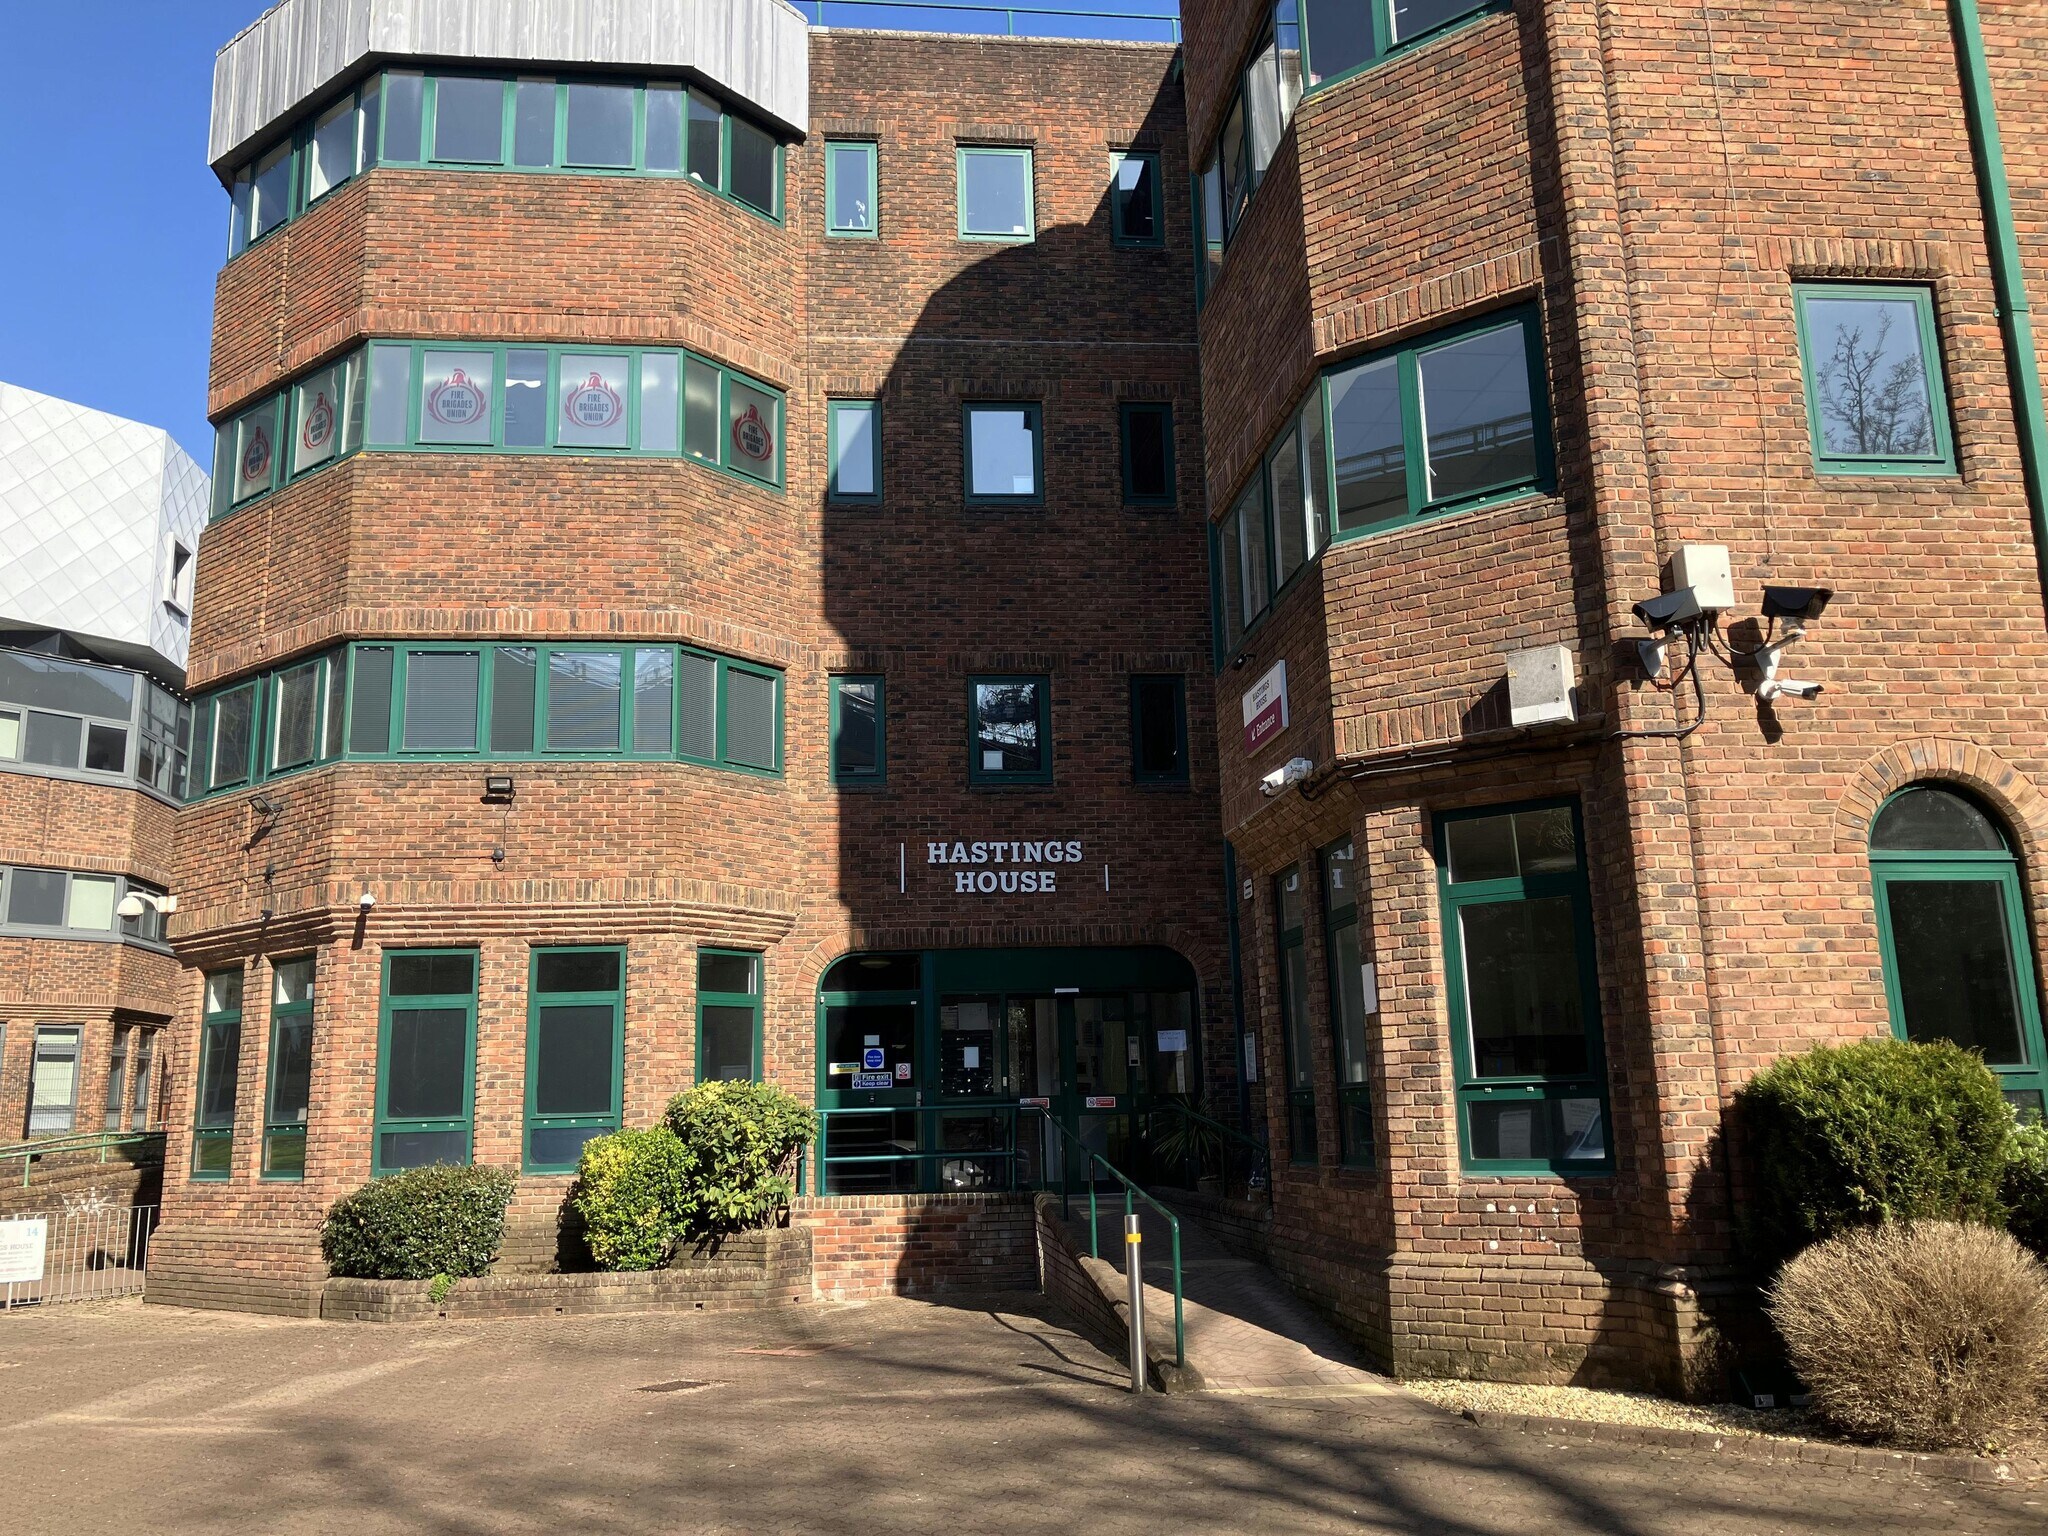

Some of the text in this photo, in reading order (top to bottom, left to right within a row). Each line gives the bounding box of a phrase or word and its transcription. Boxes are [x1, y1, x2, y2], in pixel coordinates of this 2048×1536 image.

[451, 391, 464, 399] FIRE
[588, 394, 600, 402] FIRE
[442, 400, 472, 409] BRIGADES
[579, 403, 609, 412] BRIGADES
[447, 409, 467, 418] UNION
[584, 413, 603, 421] UNION
[749, 425, 758, 436] FIRE
[743, 431, 763, 446] BRIGADES
[747, 442, 759, 454] UNION
[1256, 713, 1276, 737] Entrance
[927, 841, 1083, 863] HASTINGS
[955, 871, 1056, 893] HOUSE
[26, 1227, 39, 1236] 14
